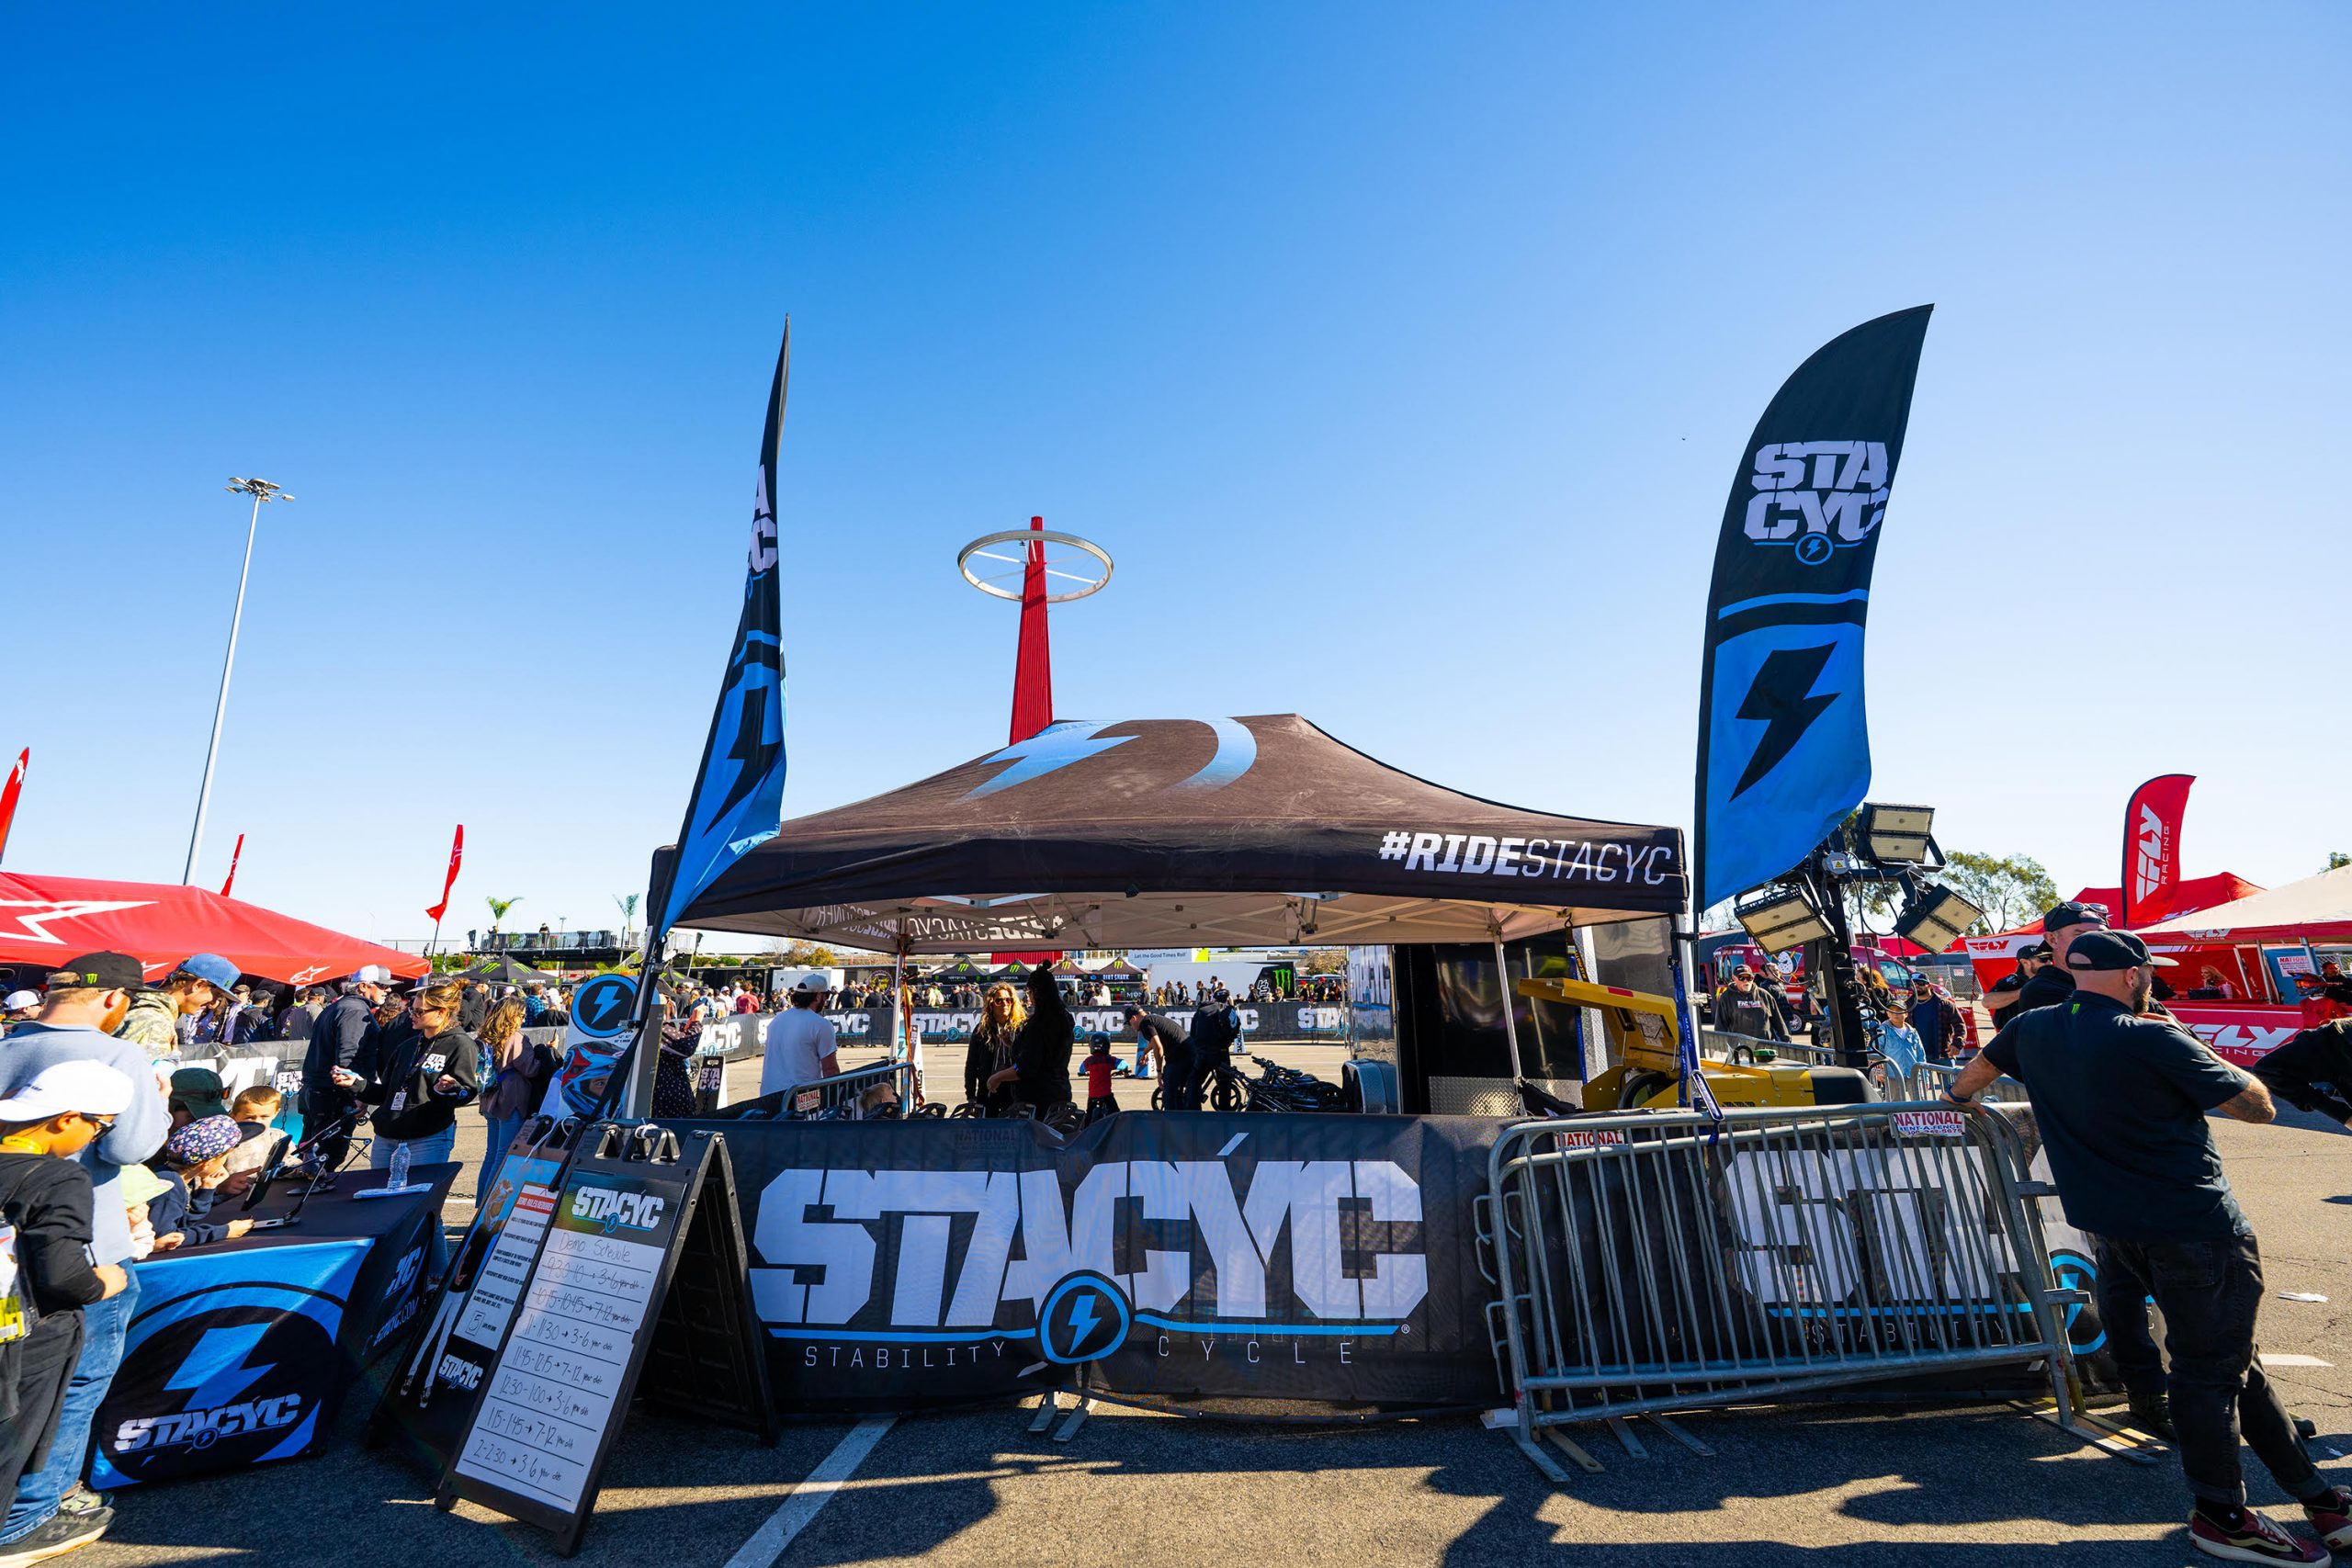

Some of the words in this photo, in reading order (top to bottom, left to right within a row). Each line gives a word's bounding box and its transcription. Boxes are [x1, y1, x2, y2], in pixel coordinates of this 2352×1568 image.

[1751, 441, 1888, 491] STA
[1744, 487, 1890, 541] CYC
[1378, 830, 1672, 886] #RIDESTACYC
[2136, 803, 2162, 905] FLY
[2161, 825, 2169, 885] RACING
[1968, 940, 2009, 951] FLY
[1894, 1112, 1963, 1126] NATIONAL
[571, 1185, 665, 1229] STACYC
[559, 1232, 585, 1252] Demo
[594, 1238, 632, 1263] Schedule
[748, 1159, 1430, 1327] STACYC
[571, 1328, 590, 1348] 3-6
[805, 1340, 1007, 1370] STABILITY
[1158, 1335, 1353, 1365] CYCLE
[561, 1361, 582, 1382] 7-12
[113, 1393, 301, 1451] STACYC
[535, 1420, 557, 1448] 7-12
